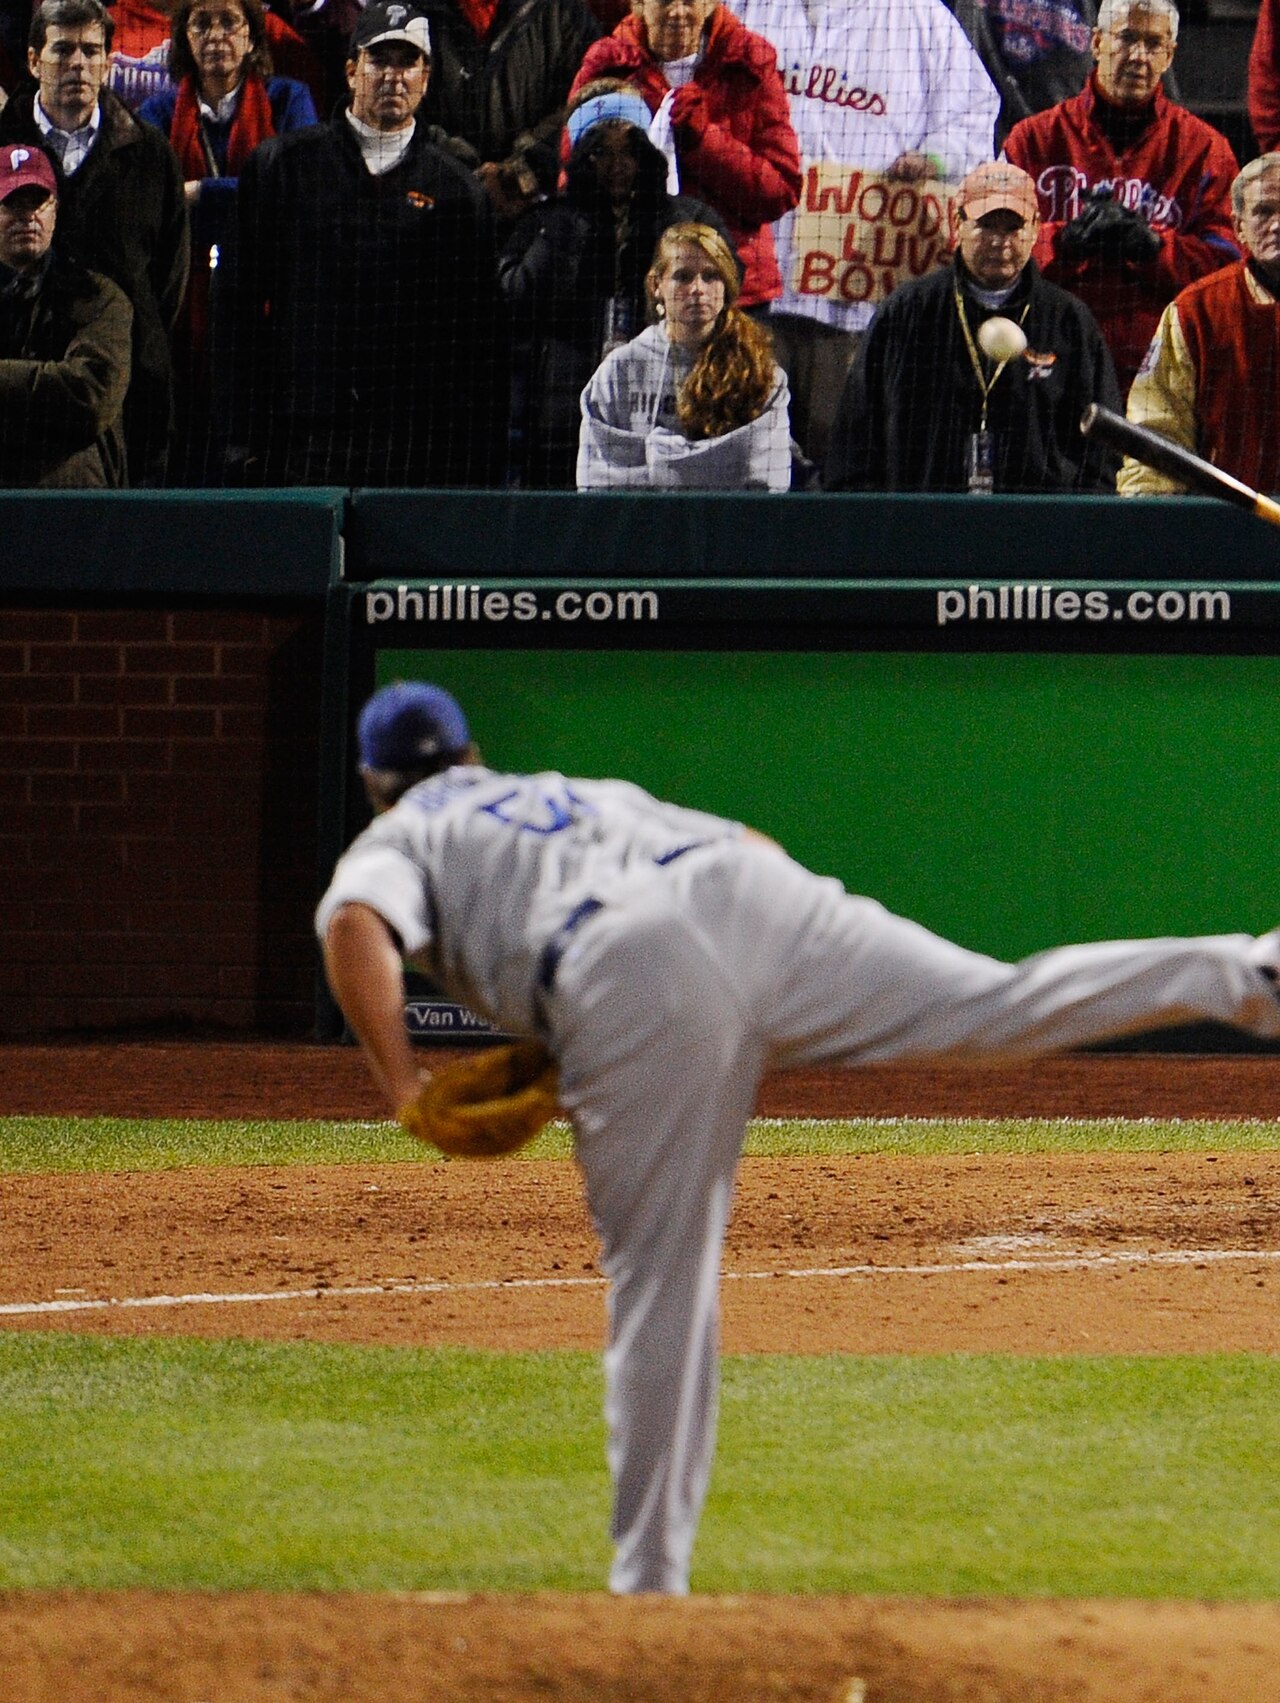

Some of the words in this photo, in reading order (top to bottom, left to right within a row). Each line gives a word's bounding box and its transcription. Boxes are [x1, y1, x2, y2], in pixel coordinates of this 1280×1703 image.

[778, 62, 888, 116] illies
[10, 149, 30, 171] P
[799, 252, 894, 301] BO
[366, 585, 659, 624] phillies.com
[937, 585, 1231, 625] phillies.com
[411, 1007, 454, 1026] Van
